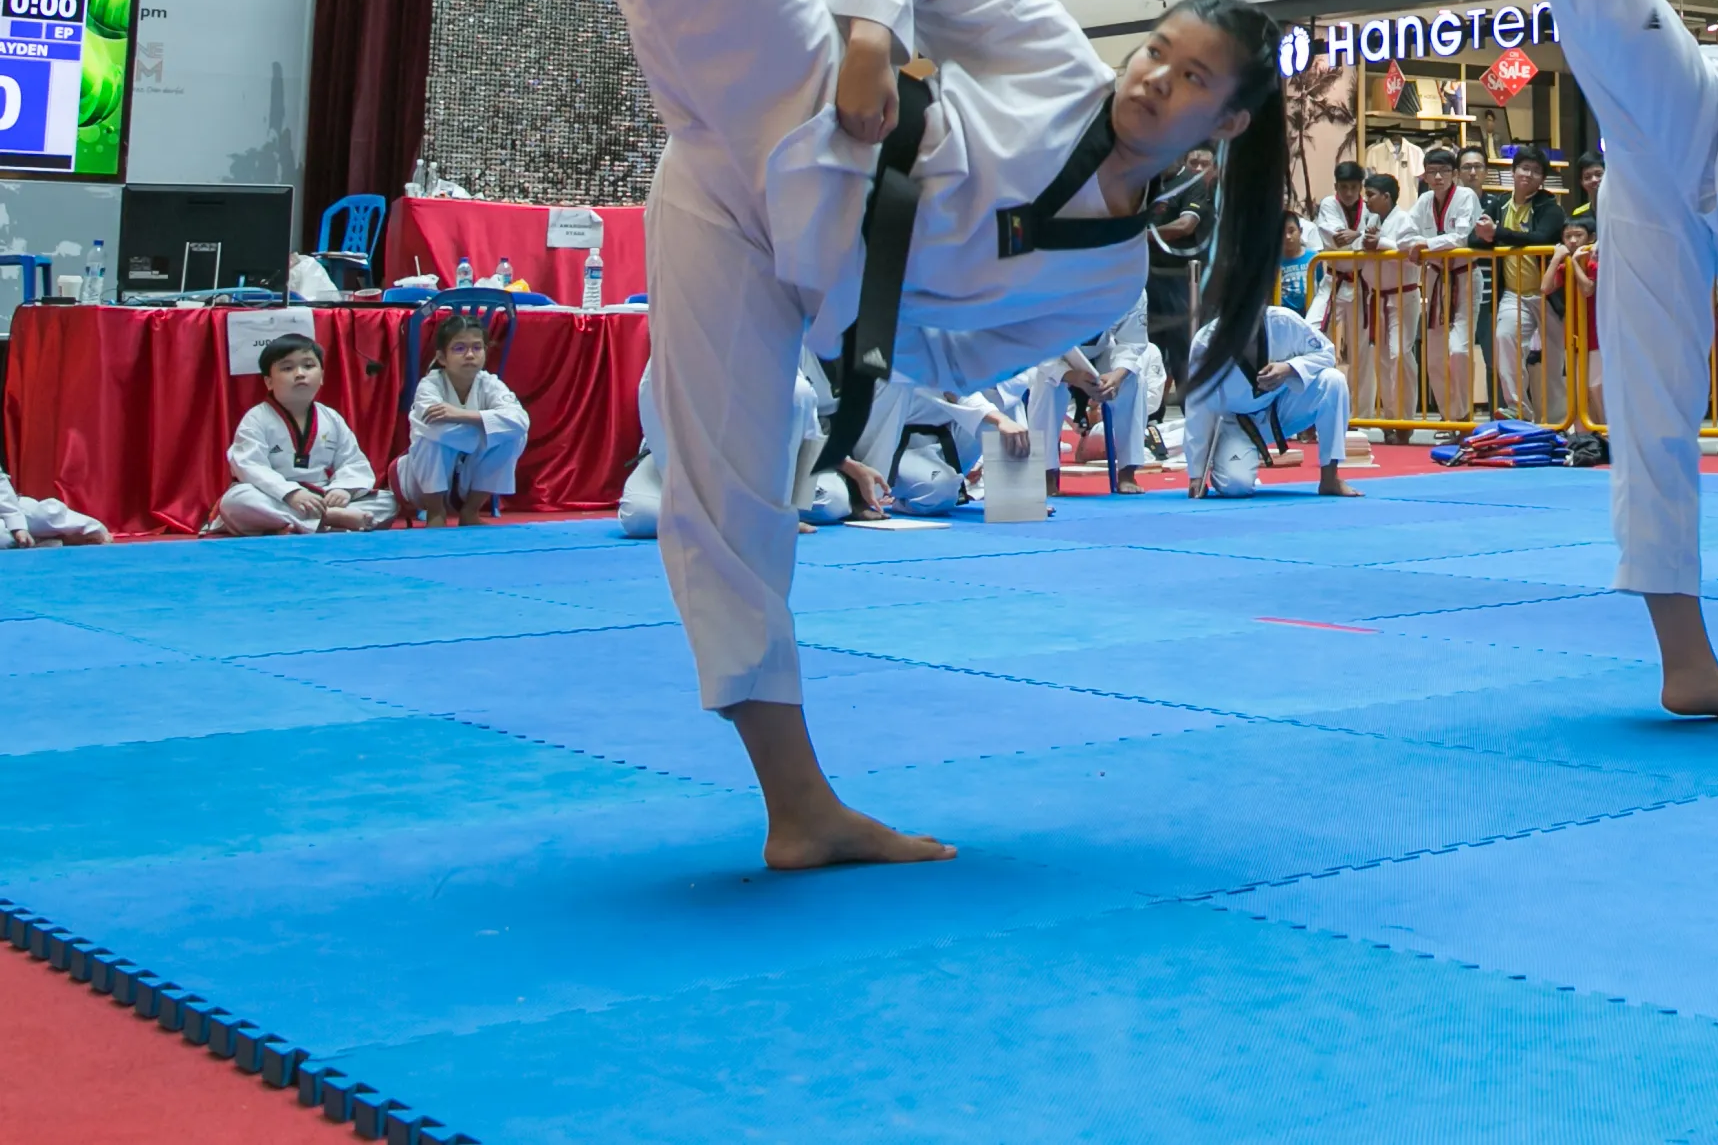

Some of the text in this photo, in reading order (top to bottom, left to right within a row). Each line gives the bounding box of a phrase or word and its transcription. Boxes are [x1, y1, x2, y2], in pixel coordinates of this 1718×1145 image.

[140, 8, 167, 20] pm
[54, 26, 74, 39] EP
[1498, 61, 1531, 80] SALE
[1487, 73, 1507, 92] SA
[253, 339, 277, 347] JUD
